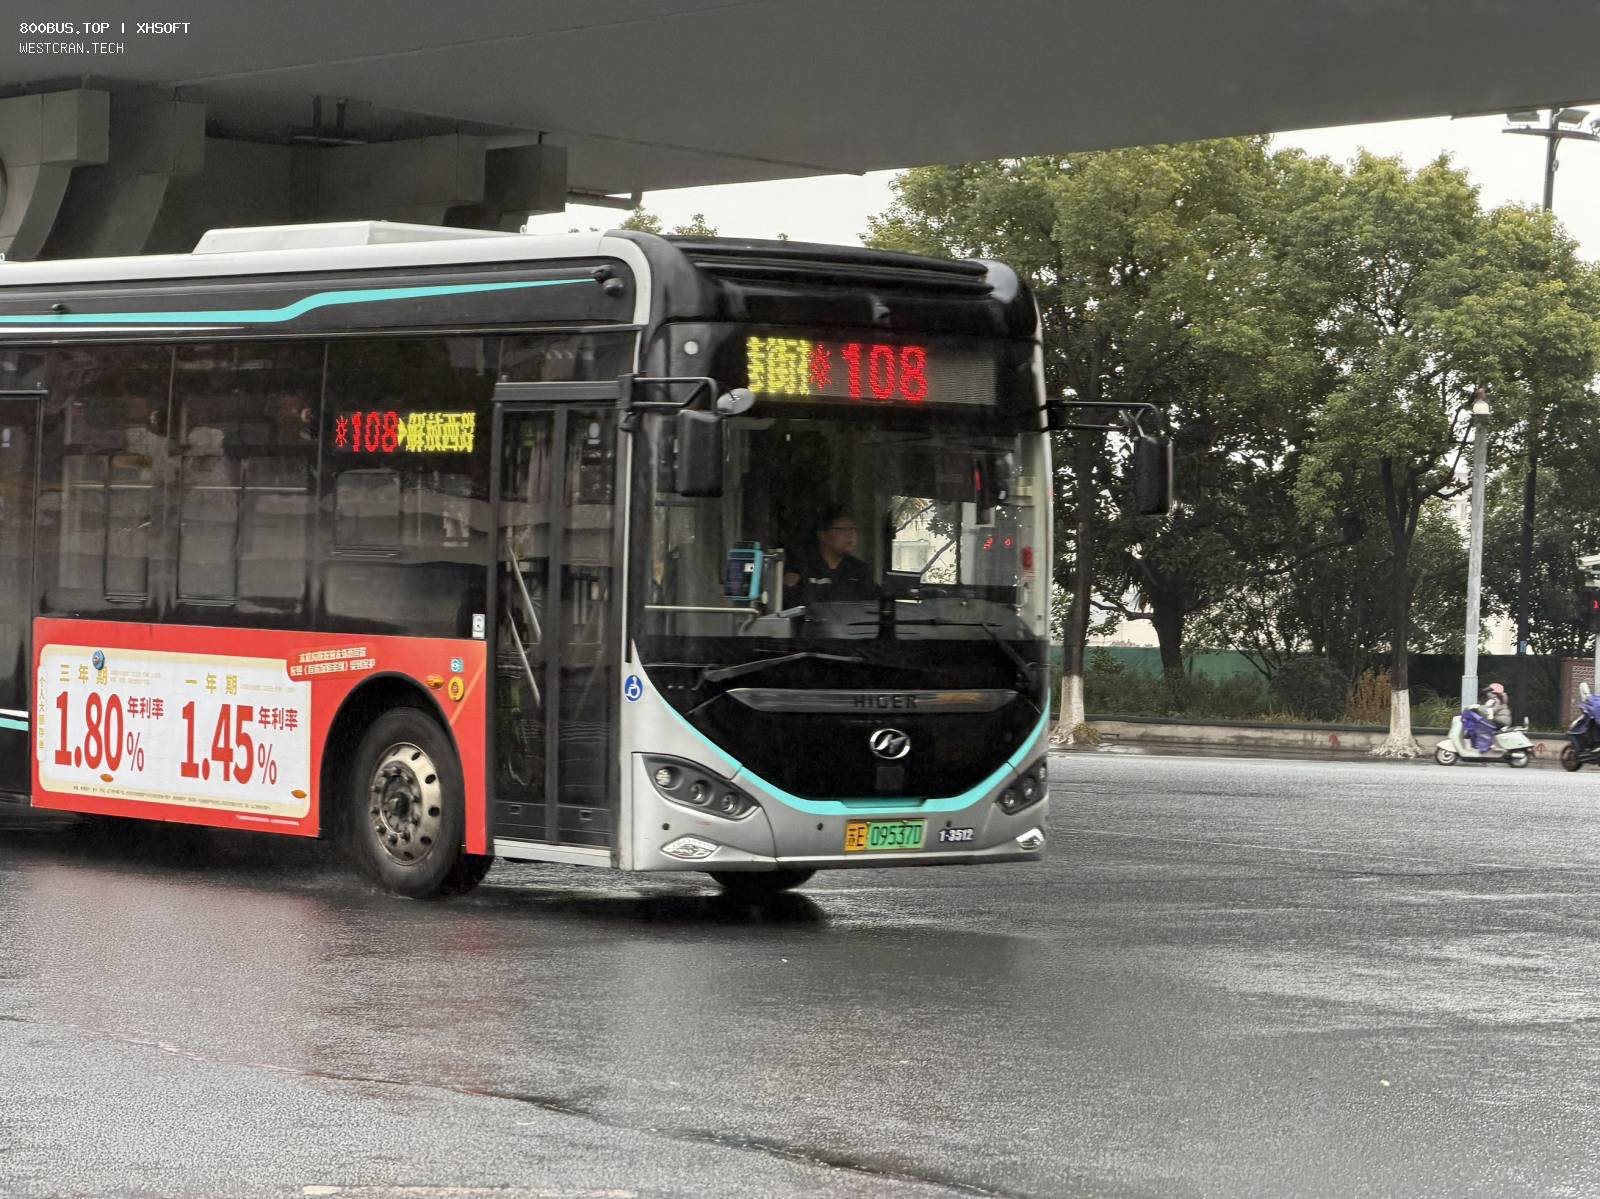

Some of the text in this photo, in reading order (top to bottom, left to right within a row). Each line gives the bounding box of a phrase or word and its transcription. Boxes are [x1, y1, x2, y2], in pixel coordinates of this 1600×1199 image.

[841, 342, 929, 404] 108
[352, 411, 399, 453] 108
[127, 695, 165, 720] 年利率
[258, 706, 299, 731] 年利率
